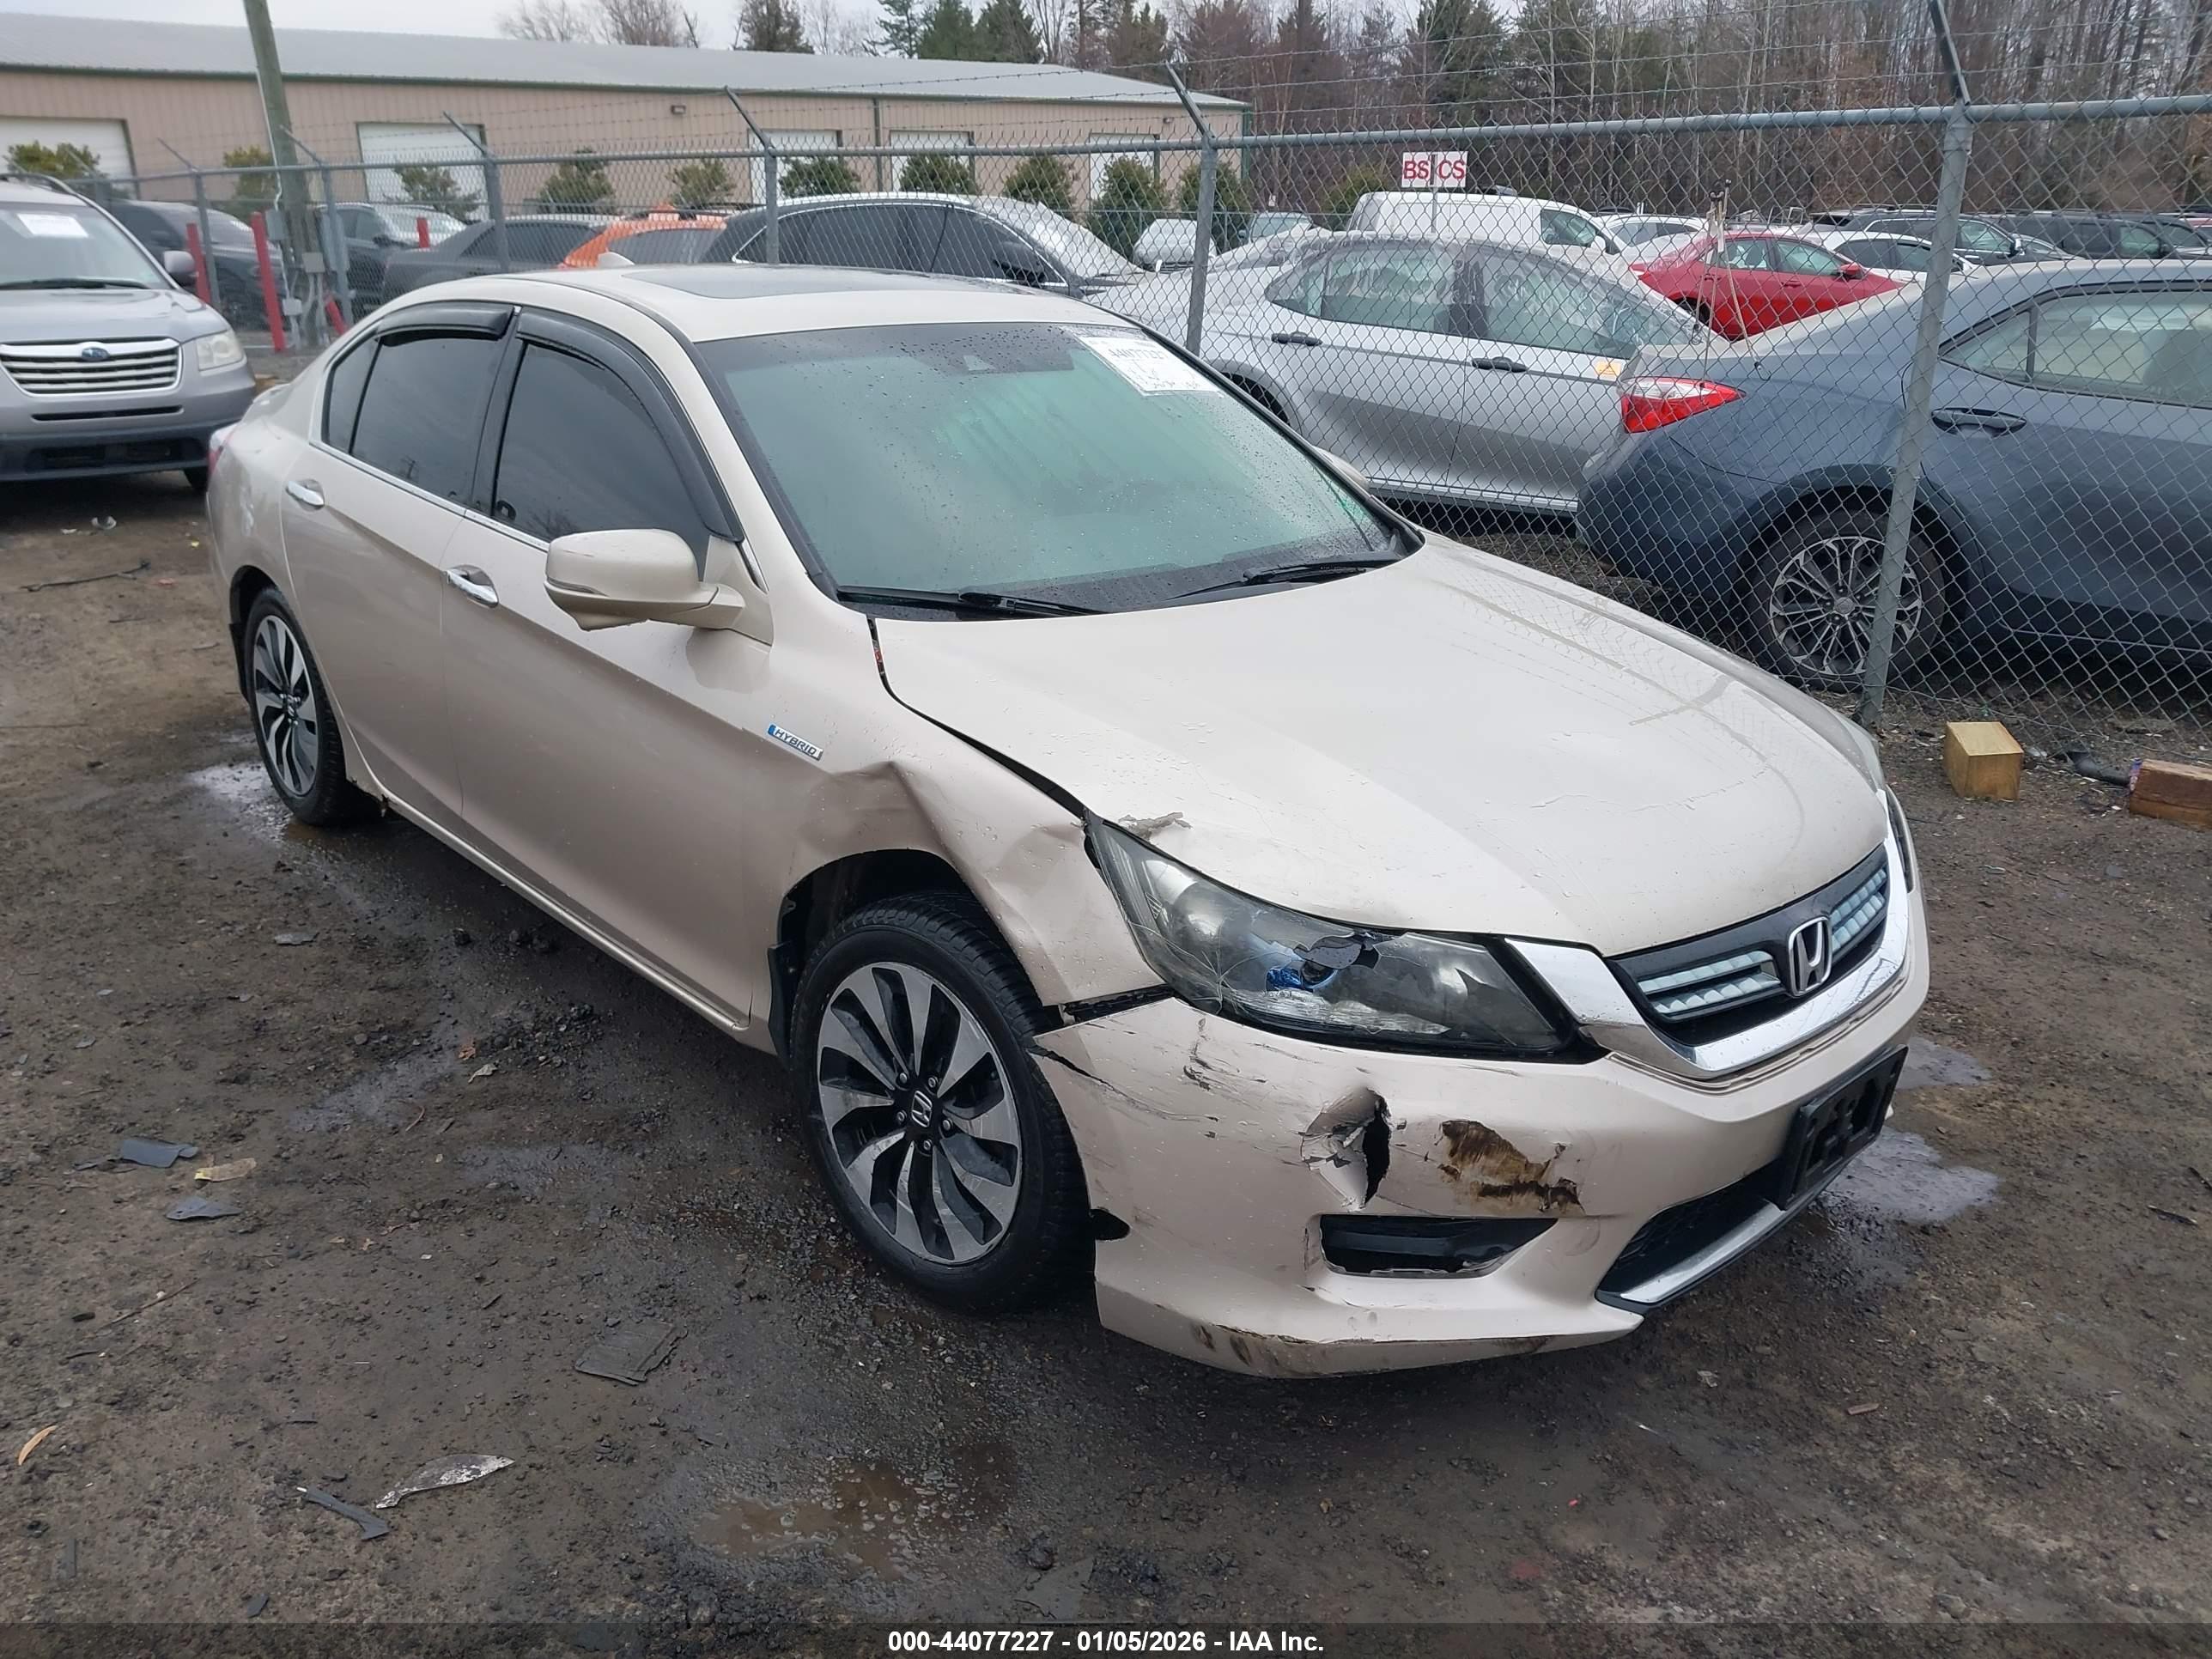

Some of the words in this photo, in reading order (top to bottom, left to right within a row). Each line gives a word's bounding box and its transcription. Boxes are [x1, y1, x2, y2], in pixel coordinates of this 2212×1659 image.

[1403, 161, 1429, 179] BS
[1438, 160, 1466, 179] CS
[775, 729, 817, 756] HYBRID
